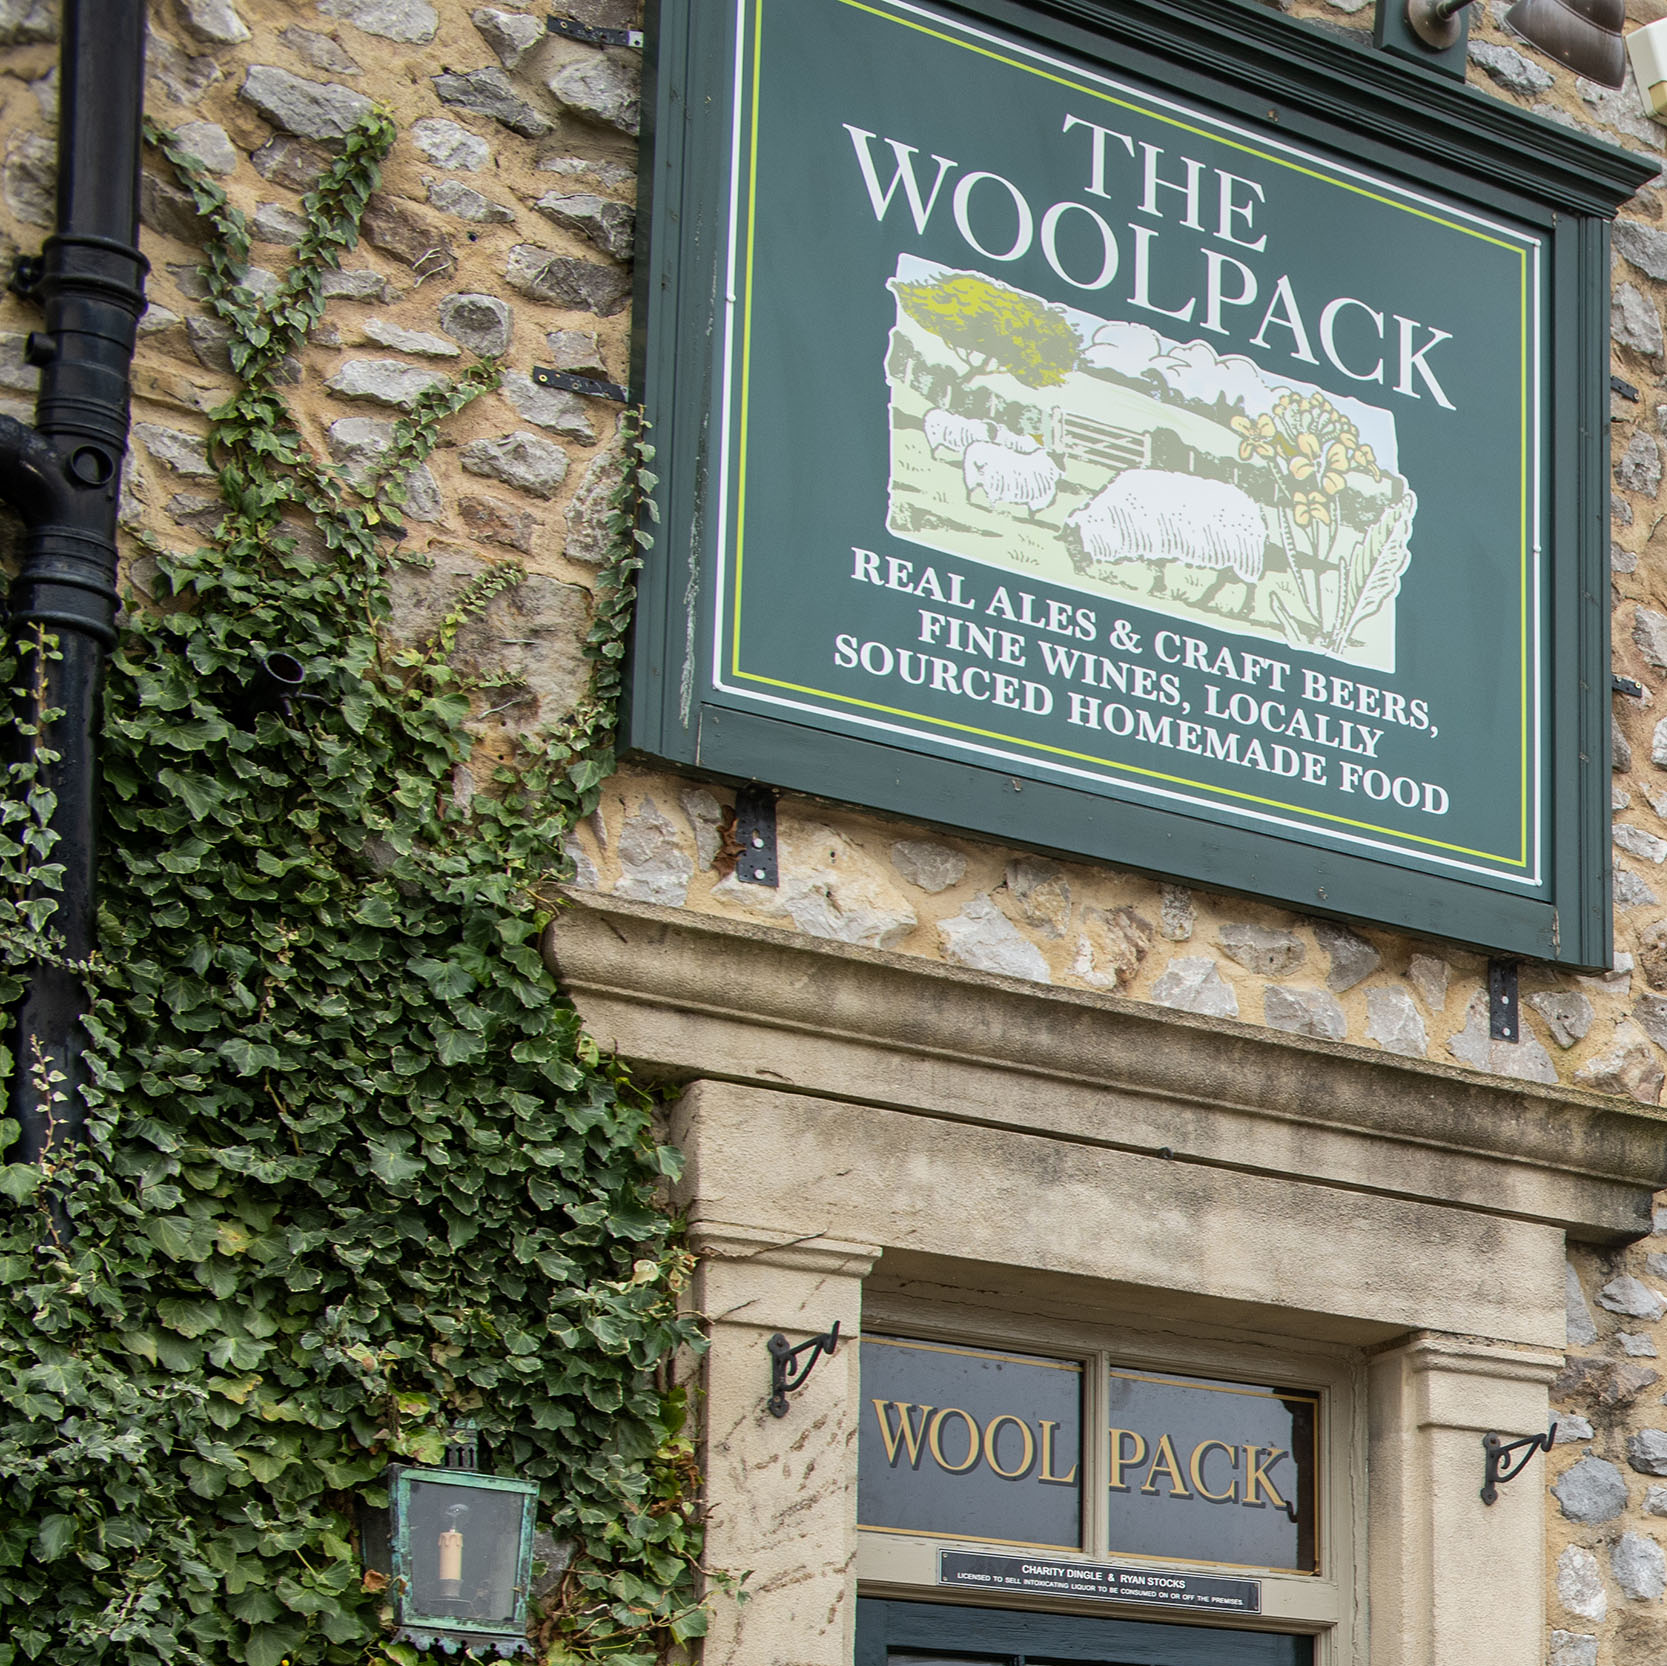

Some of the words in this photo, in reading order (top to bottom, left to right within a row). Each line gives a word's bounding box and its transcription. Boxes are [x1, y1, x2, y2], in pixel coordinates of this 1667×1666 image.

[1062, 113, 1268, 253] THE
[842, 123, 1457, 411] WOOLPACK
[850, 546, 976, 610] REAL
[985, 585, 1097, 641] ALES
[1109, 619, 1143, 654] &
[1154, 630, 1291, 693] CRAFT
[1300, 668, 1438, 739] BEERS,
[917, 609, 1026, 667] FINE
[1037, 640, 1191, 715] WINES,
[1204, 684, 1385, 758] LOCALLY
[834, 633, 1054, 716] SOURCED
[1066, 691, 1328, 786] HOMEMADE
[1338, 760, 1449, 815] FOOD
[873, 1399, 1080, 1485] WOOL
[1109, 1427, 1289, 1510] PACK
[957, 1572, 991, 1582] LICENSED
[993, 1575, 1004, 1583] TO
[1005, 1577, 1022, 1585] SELL
[1023, 1579, 1070, 1589] INTOXICATING
[1070, 1583, 1096, 1592] LIQUOR
[1097, 1585, 1108, 1593] TO
[1109, 1586, 1119, 1594] BE
[1120, 1587, 1157, 1598] CONSUMED
[1158, 1591, 1169, 1599] ON
[1170, 1592, 1181, 1600] OR
[1182, 1593, 1195, 1601] OFF
[1197, 1595, 1210, 1603] THE
[1021, 1564, 1065, 1577] CHARITY
[1066, 1567, 1103, 1581] DINGLE
[1107, 1573, 1116, 1582] &
[1120, 1574, 1146, 1586] RYAN
[1147, 1577, 1186, 1589] STOCKS
